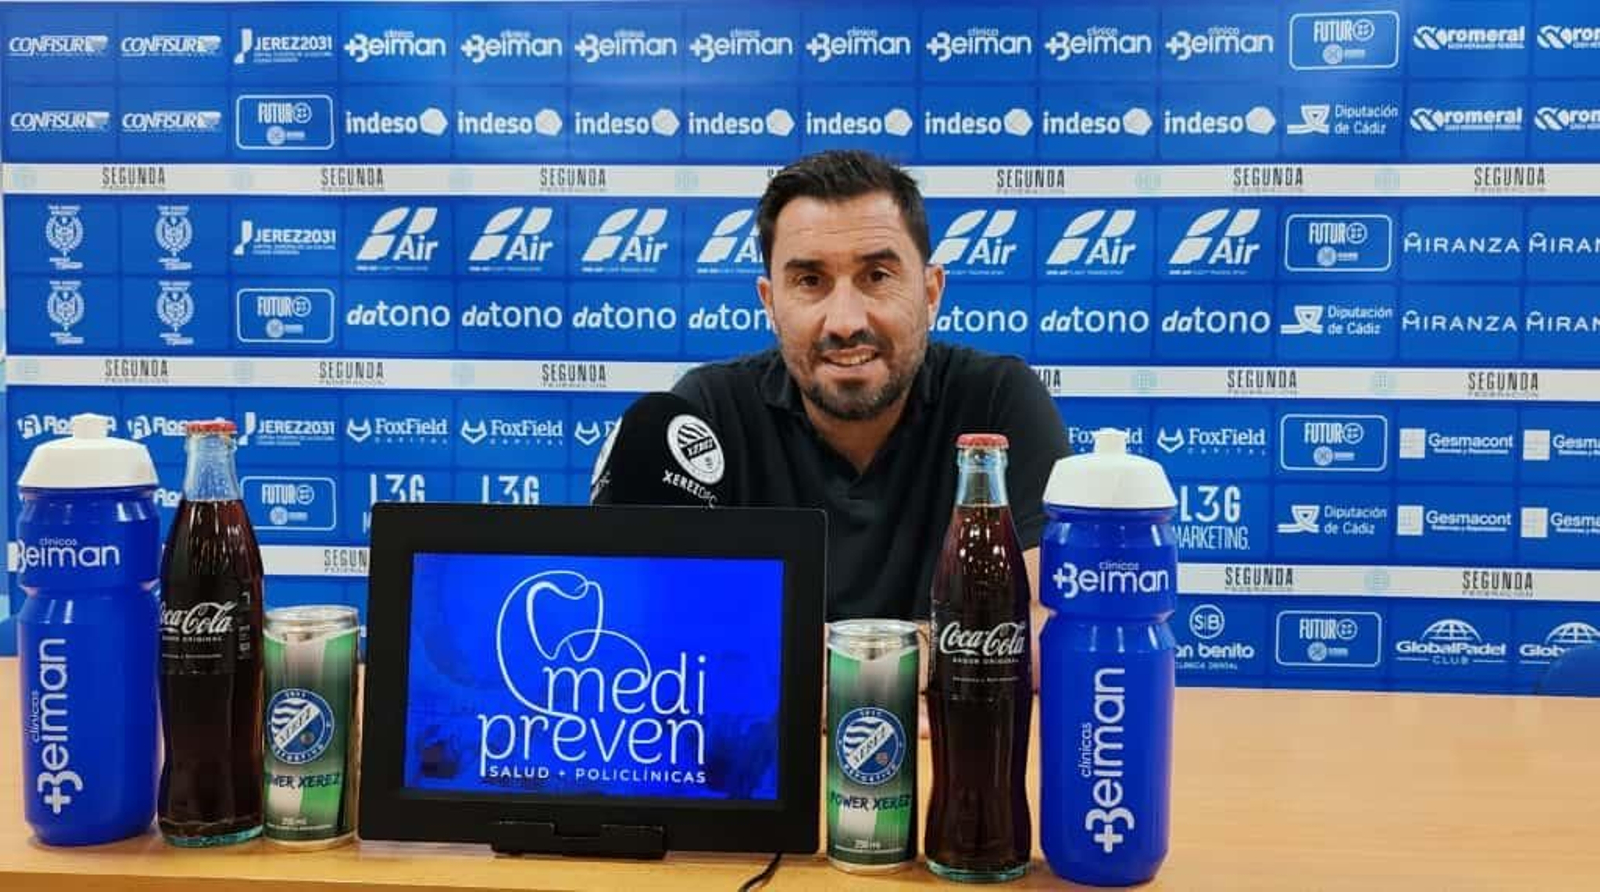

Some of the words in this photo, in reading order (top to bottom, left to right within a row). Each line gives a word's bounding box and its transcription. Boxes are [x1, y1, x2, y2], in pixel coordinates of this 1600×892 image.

[254, 36, 332, 50] JEREZ2031
[1448, 26, 1525, 42] romeral
[1335, 104, 1398, 120] Diputación
[1444, 107, 1522, 123] romeral
[346, 111, 418, 134] indeso
[458, 111, 532, 135] indeso
[575, 112, 649, 135] indeso
[689, 112, 763, 135] indeso
[806, 112, 883, 135] indeso
[925, 112, 1001, 135] indeso
[1043, 111, 1120, 135] indeso
[1164, 110, 1243, 134] indeso
[1335, 121, 1349, 134] de
[1354, 120, 1386, 134] Cádiz
[102, 167, 165, 185] SEGUNDA
[321, 168, 383, 186] SEGUNDA
[540, 168, 606, 186] SEGUNDA
[997, 169, 1065, 188] SEGUNDA
[1233, 168, 1304, 186] SEGUNDA
[1474, 167, 1545, 186] SEGUNDA
[254, 229, 335, 243] JEREZ2031
[394, 235, 438, 261] Air
[506, 236, 553, 262] Air
[620, 237, 667, 263] Air
[967, 238, 1017, 264] Air
[1086, 238, 1136, 264] Air
[1209, 237, 1260, 264] Air
[346, 300, 450, 326] datono
[462, 301, 562, 327] datono
[573, 302, 676, 329] datono
[688, 304, 771, 331] daton
[928, 305, 1028, 333] atono
[1040, 305, 1149, 333] datono
[1162, 306, 1270, 333] datono
[1327, 305, 1393, 320] Diputación
[1327, 322, 1343, 335] de
[1347, 321, 1380, 335] Cádiz
[105, 360, 168, 377] SEGUNDA
[319, 362, 384, 379] SEGUNDA
[542, 364, 606, 382] SEGUNDA
[1227, 370, 1297, 388] SEGUNDA
[1469, 372, 1538, 390] SEGUNDA
[257, 420, 335, 434] JEREZ2031
[375, 418, 447, 435] FoxField
[491, 420, 563, 437] FoxField
[1069, 427, 1143, 444] Fold
[1189, 428, 1265, 446] FoxField
[1428, 433, 1513, 448] Gesmacont
[1180, 485, 1241, 523] L3G
[1324, 506, 1387, 521] Diputación
[1426, 510, 1511, 526] Gesmacont
[1324, 523, 1339, 535] de
[1343, 521, 1375, 535] Cádiz
[324, 549, 368, 567] SEGUN
[1225, 568, 1293, 586] SEGUNDA
[1462, 571, 1533, 590] SEGUNDA
[940, 621, 1026, 657] Coca-Cola
[1396, 640, 1506, 656] GlobalPadel
[1198, 642, 1255, 659] benito
[1432, 656, 1469, 665] CLUB
[543, 651, 705, 716] medi
[478, 712, 706, 777] preven
[1085, 668, 1134, 853] Beiman
[489, 765, 549, 779] SALUD
[575, 766, 706, 784] POLICLÍNICAS
